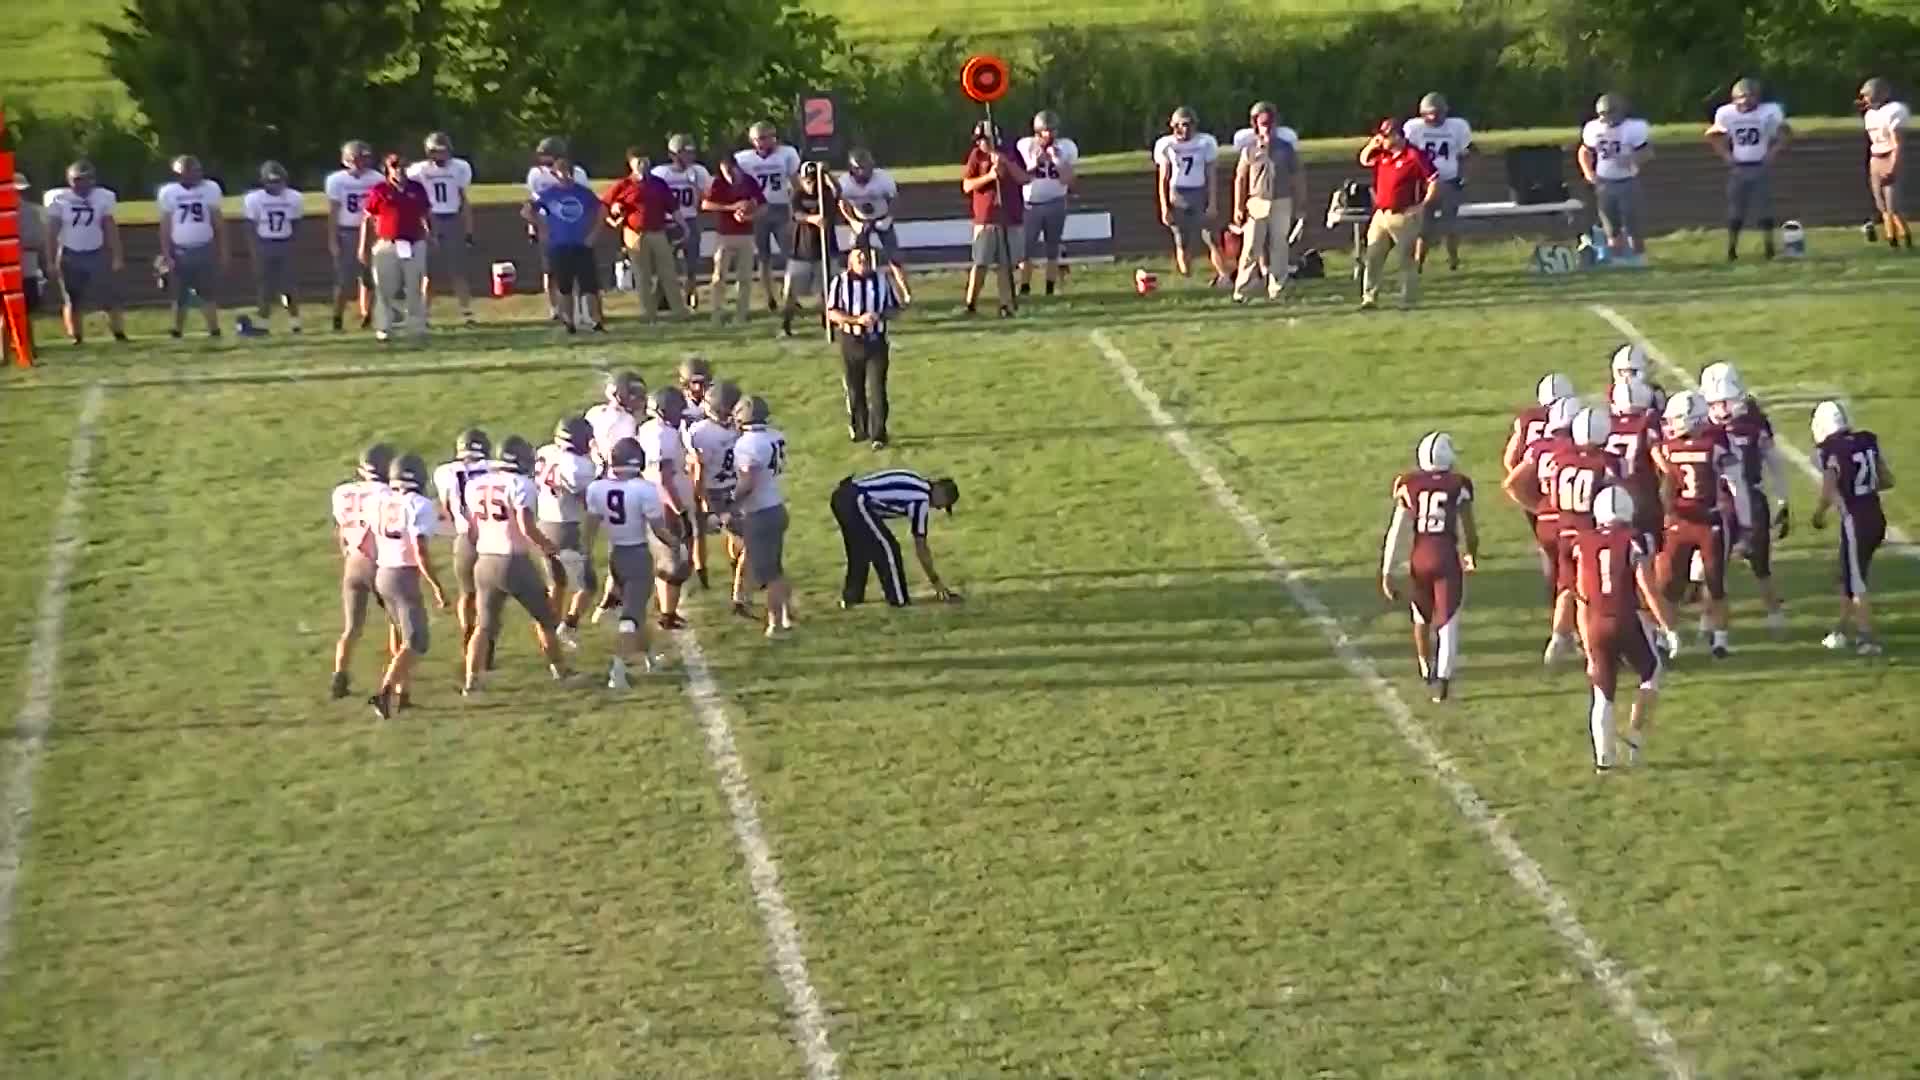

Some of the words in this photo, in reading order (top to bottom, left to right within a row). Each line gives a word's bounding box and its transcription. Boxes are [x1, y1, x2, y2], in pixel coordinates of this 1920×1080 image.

[804, 98, 834, 136] 2
[1182, 157, 1194, 176] 7
[433, 183, 447, 203] 11
[757, 173, 781, 192] 75
[71, 206, 94, 227] 77
[177, 202, 203, 224] 79
[267, 210, 286, 231] 17
[1679, 463, 1697, 499] 3
[1852, 448, 1880, 496] 21
[606, 489, 626, 526] 9
[1598, 547, 1613, 594] 1
